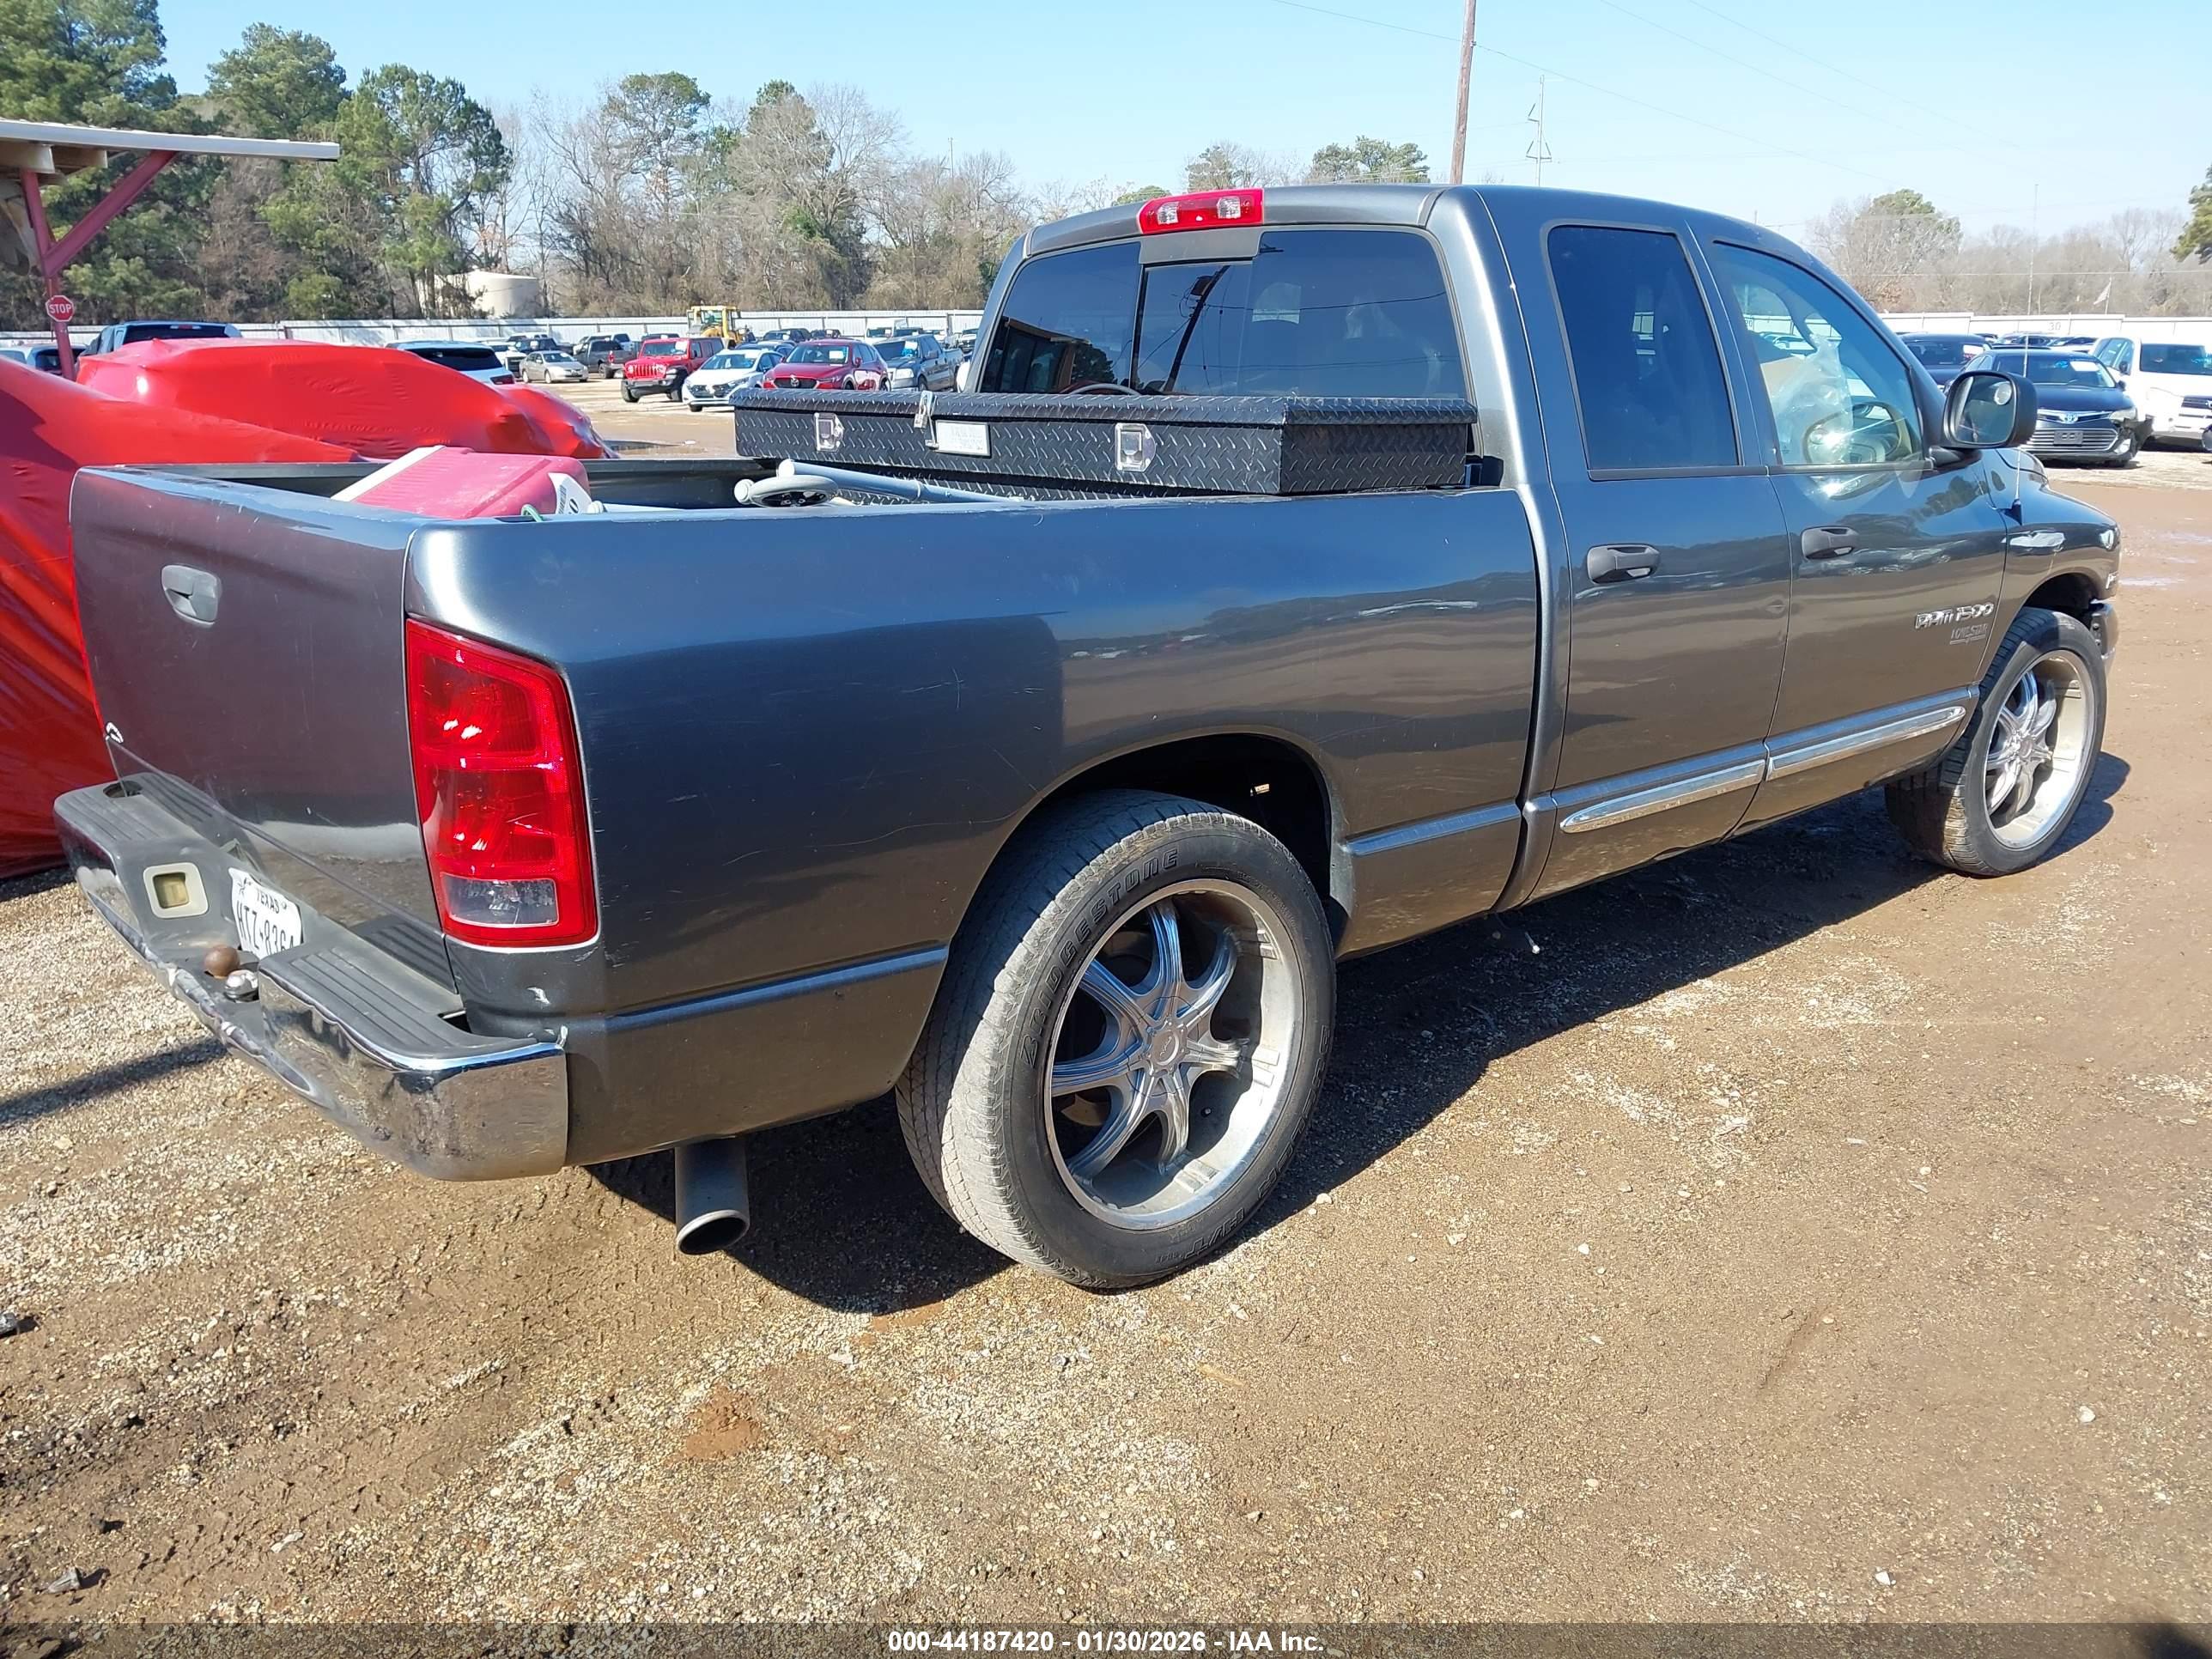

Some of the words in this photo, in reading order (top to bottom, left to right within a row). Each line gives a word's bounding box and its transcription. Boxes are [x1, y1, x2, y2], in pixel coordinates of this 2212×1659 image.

[49, 304, 71, 314] STOP
[2048, 322, 2061, 331] 30
[1915, 609, 1954, 629] RAM
[1955, 602, 1994, 621] 1500
[256, 888, 280, 914] TEXAS
[1020, 848, 1178, 1067] BRIDGESTONE
